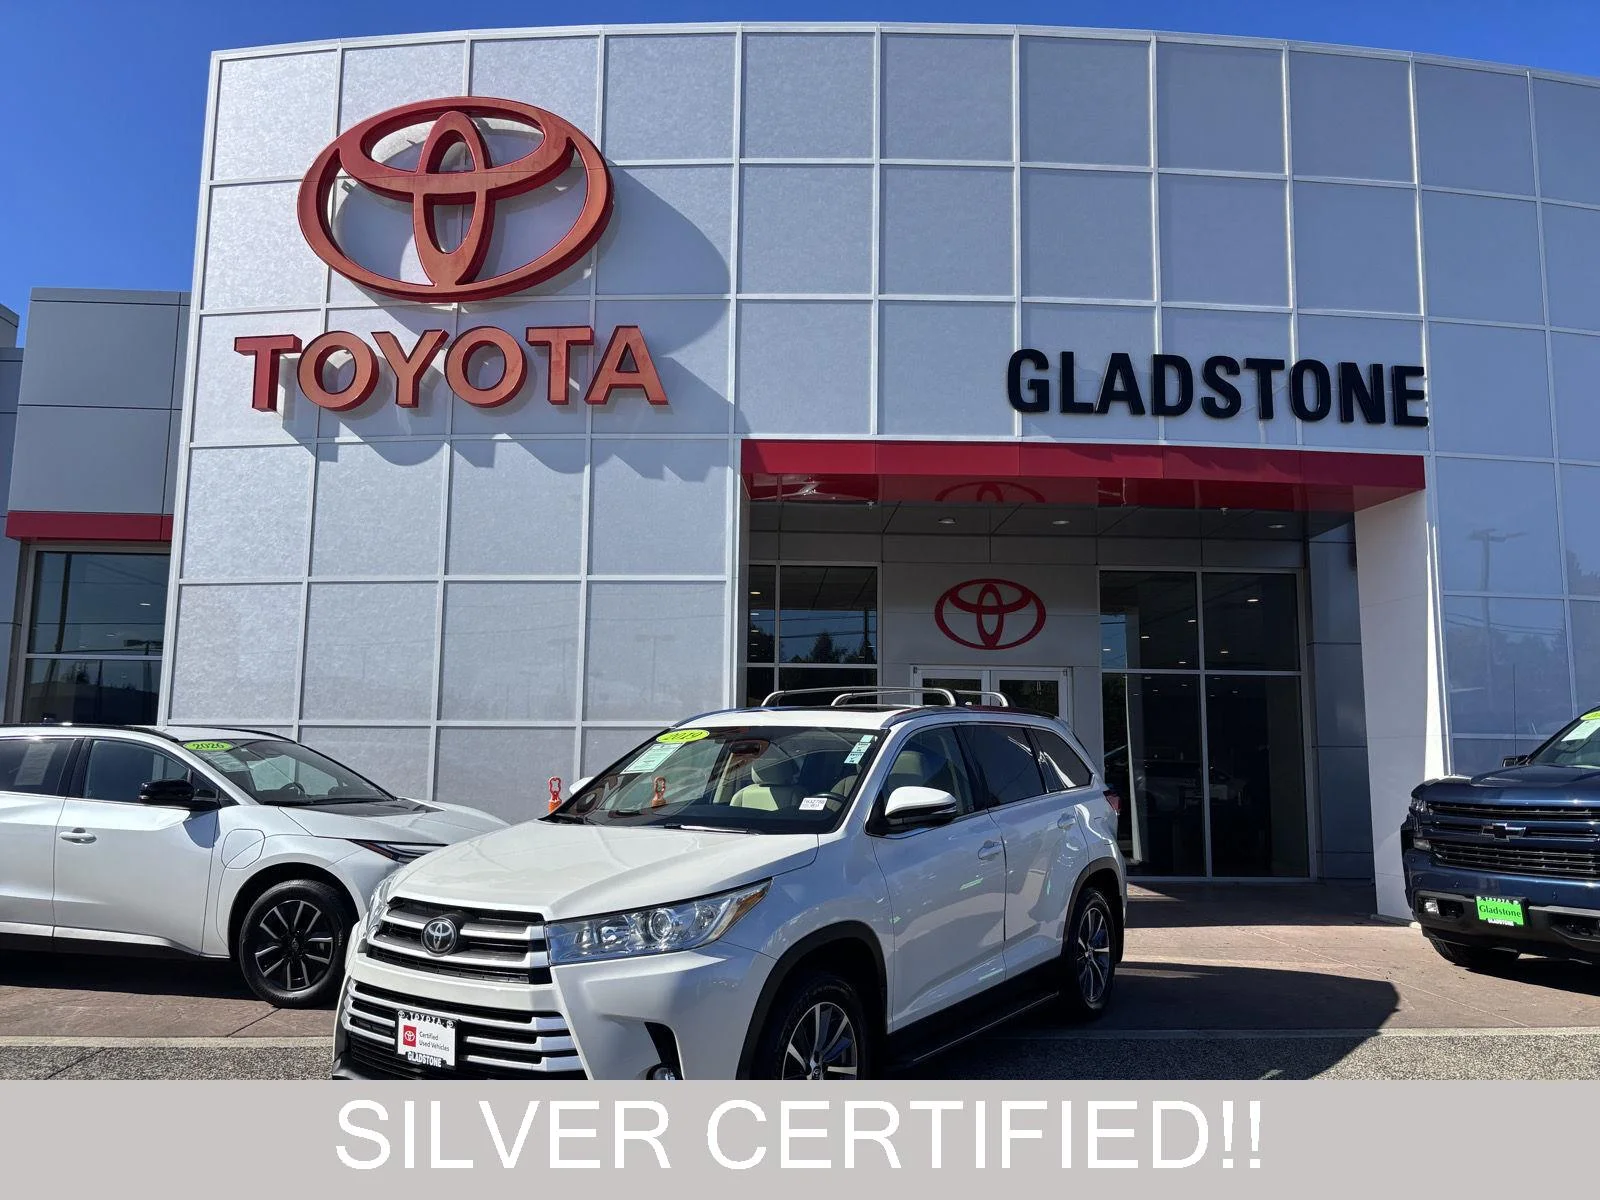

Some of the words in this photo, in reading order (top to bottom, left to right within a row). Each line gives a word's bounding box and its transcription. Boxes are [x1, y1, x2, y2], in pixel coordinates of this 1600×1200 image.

[234, 325, 669, 413] TOYOTA
[1007, 348, 1429, 427] GLADSTONE
[1479, 904, 1521, 918] Gladstone
[409, 1011, 442, 1026] TOYOTA
[419, 1031, 439, 1041] Certified
[419, 1040, 431, 1048] Used
[431, 1042, 450, 1052] Vehicles
[407, 1051, 442, 1068] GLADSTONE
